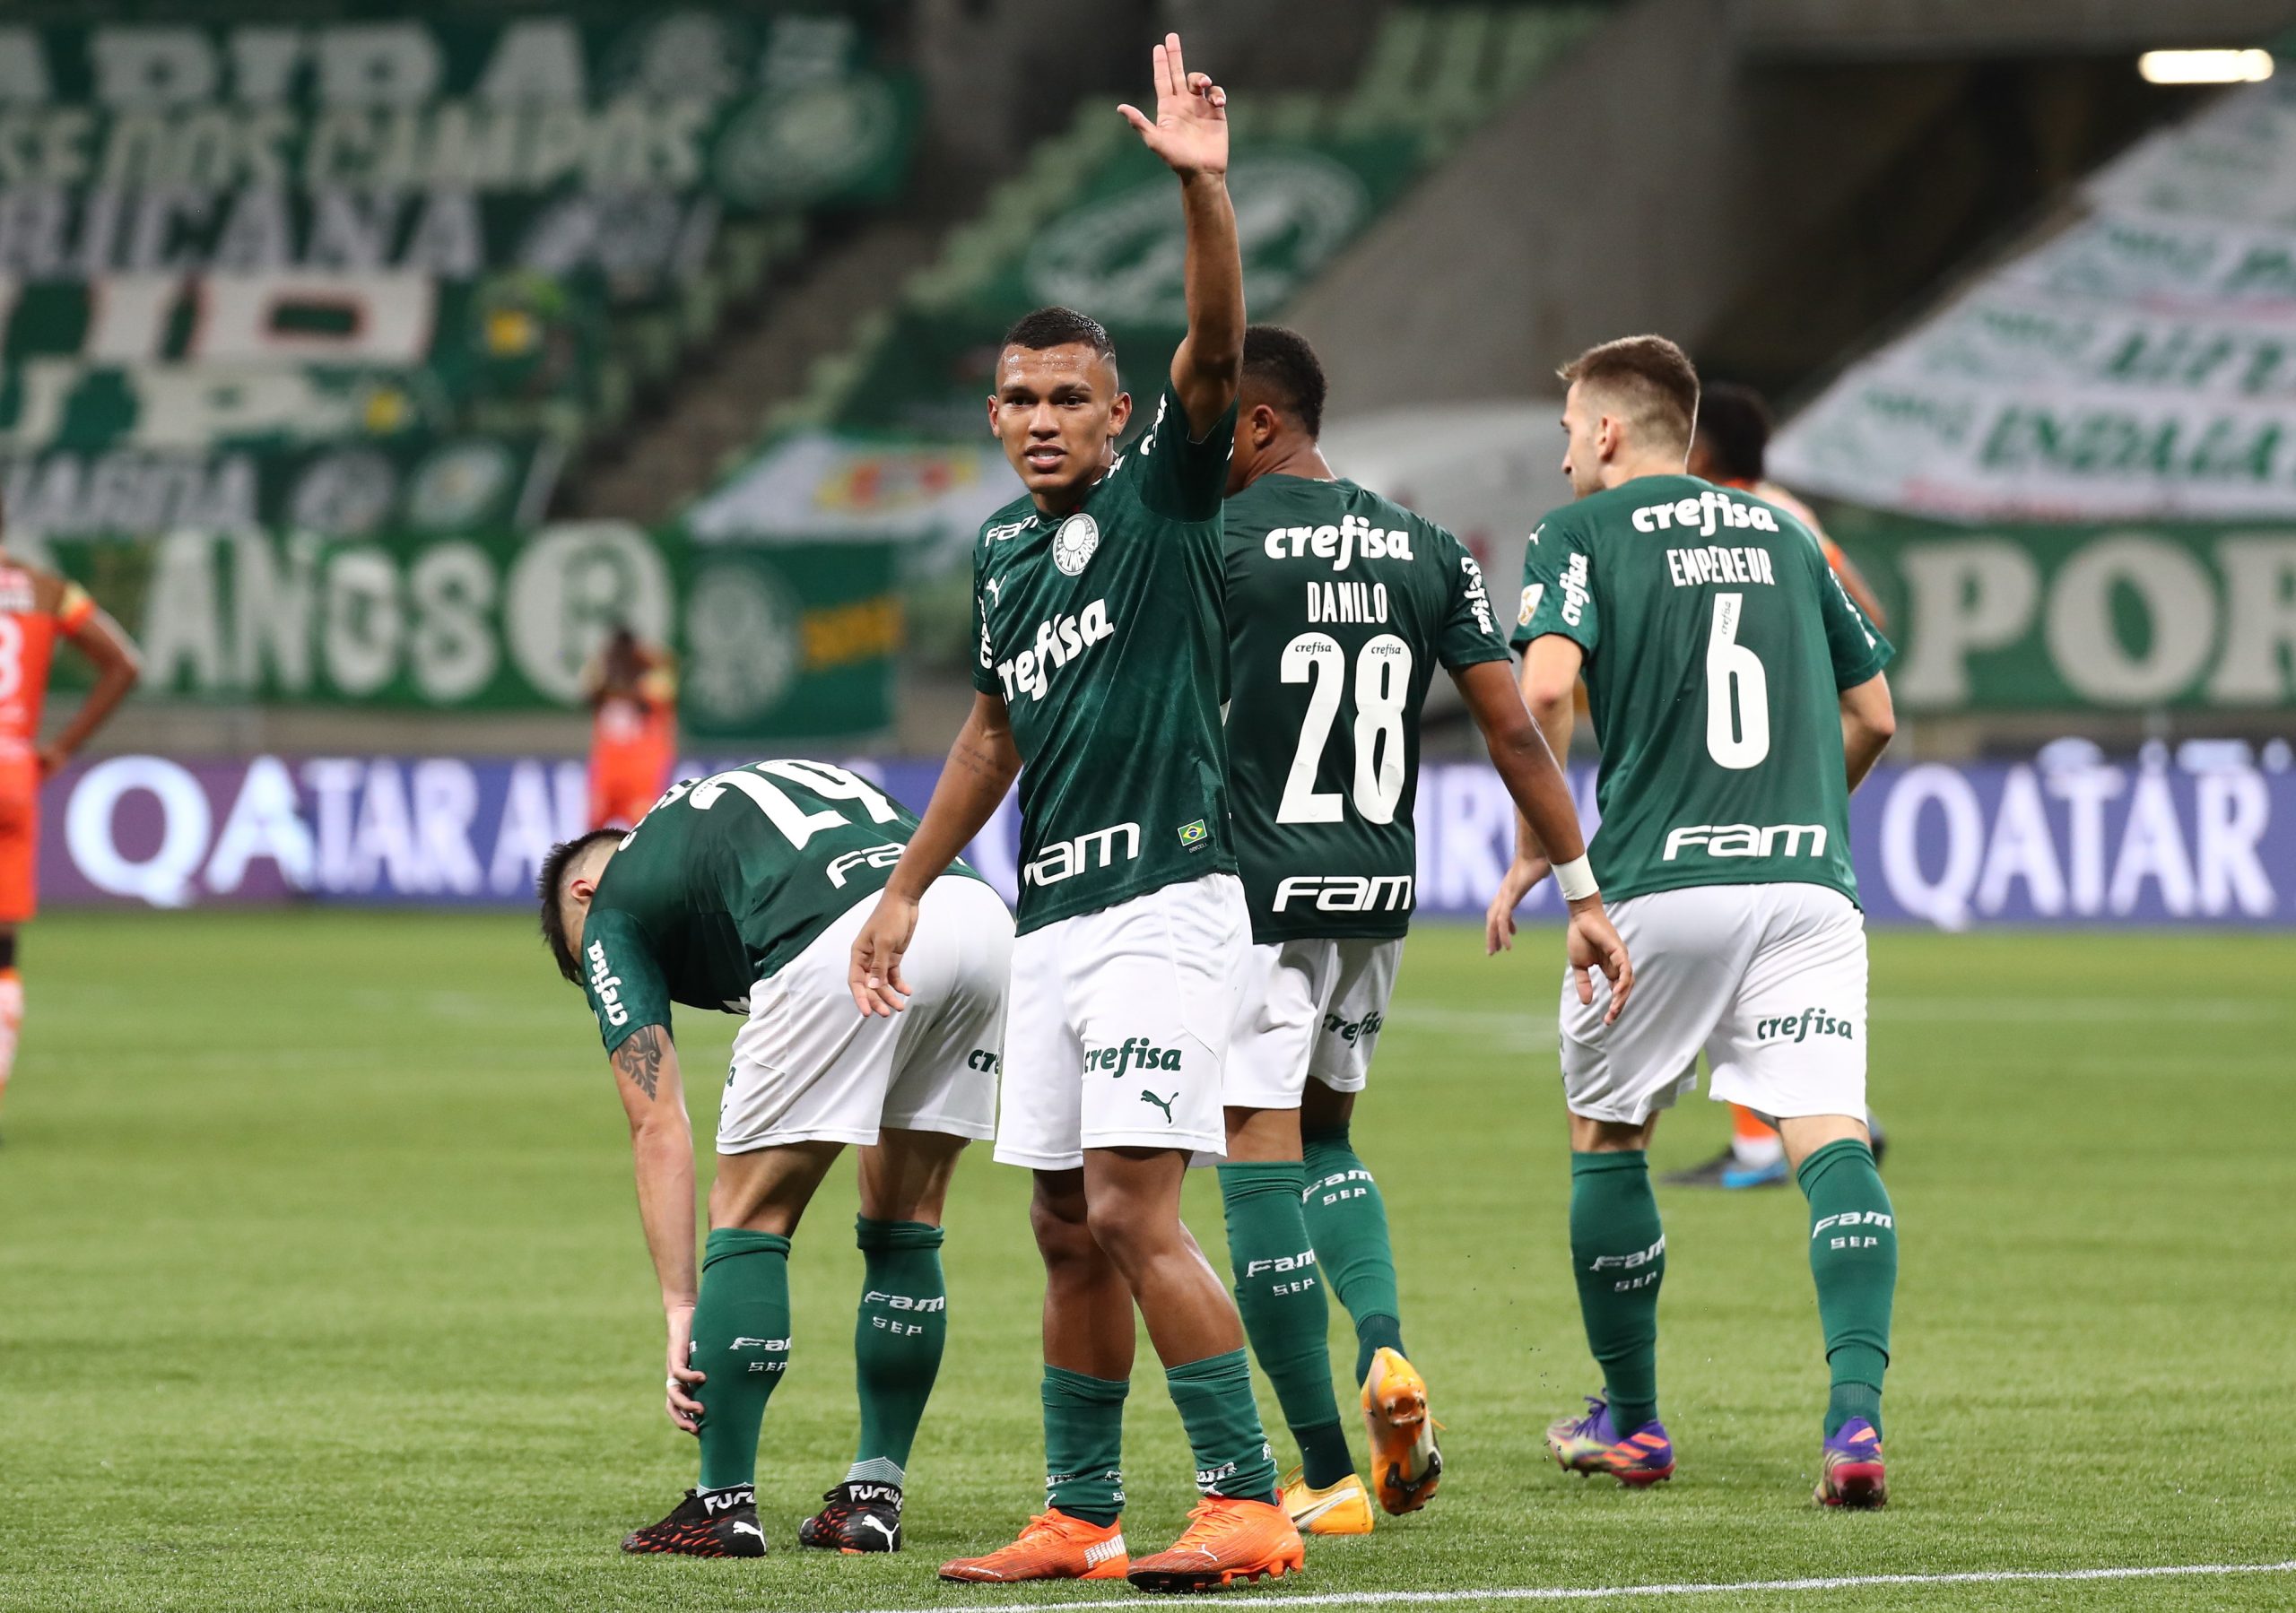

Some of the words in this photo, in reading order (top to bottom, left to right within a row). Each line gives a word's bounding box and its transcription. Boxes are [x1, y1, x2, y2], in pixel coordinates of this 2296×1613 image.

[1631, 491, 1779, 536] crefisa
[1056, 531, 1096, 574] PALMEIRAS
[1264, 514, 1413, 571] crefisa
[1665, 546, 1775, 586] EMPEREUR
[1307, 581, 1387, 624] DANILO
[1461, 557, 1494, 635] crefisa
[1560, 552, 1590, 626] crefisa
[1295, 641, 1332, 657] crefisa
[1370, 643, 1401, 659] crefisa
[1706, 593, 1770, 769] 6
[1275, 631, 1413, 825] 28
[65, 754, 482, 908] QATAR
[1880, 762, 2278, 932] QATAR
[587, 940, 628, 1026] crefisa
[1757, 1008, 1853, 1044] crefisa
[1084, 1037, 1182, 1079] crefisa
[1323, 1188, 1367, 1206] SEP
[1831, 1236, 1878, 1250] SEP
[1273, 1278, 1316, 1296] SEP
[873, 1316, 922, 1337] SEP
